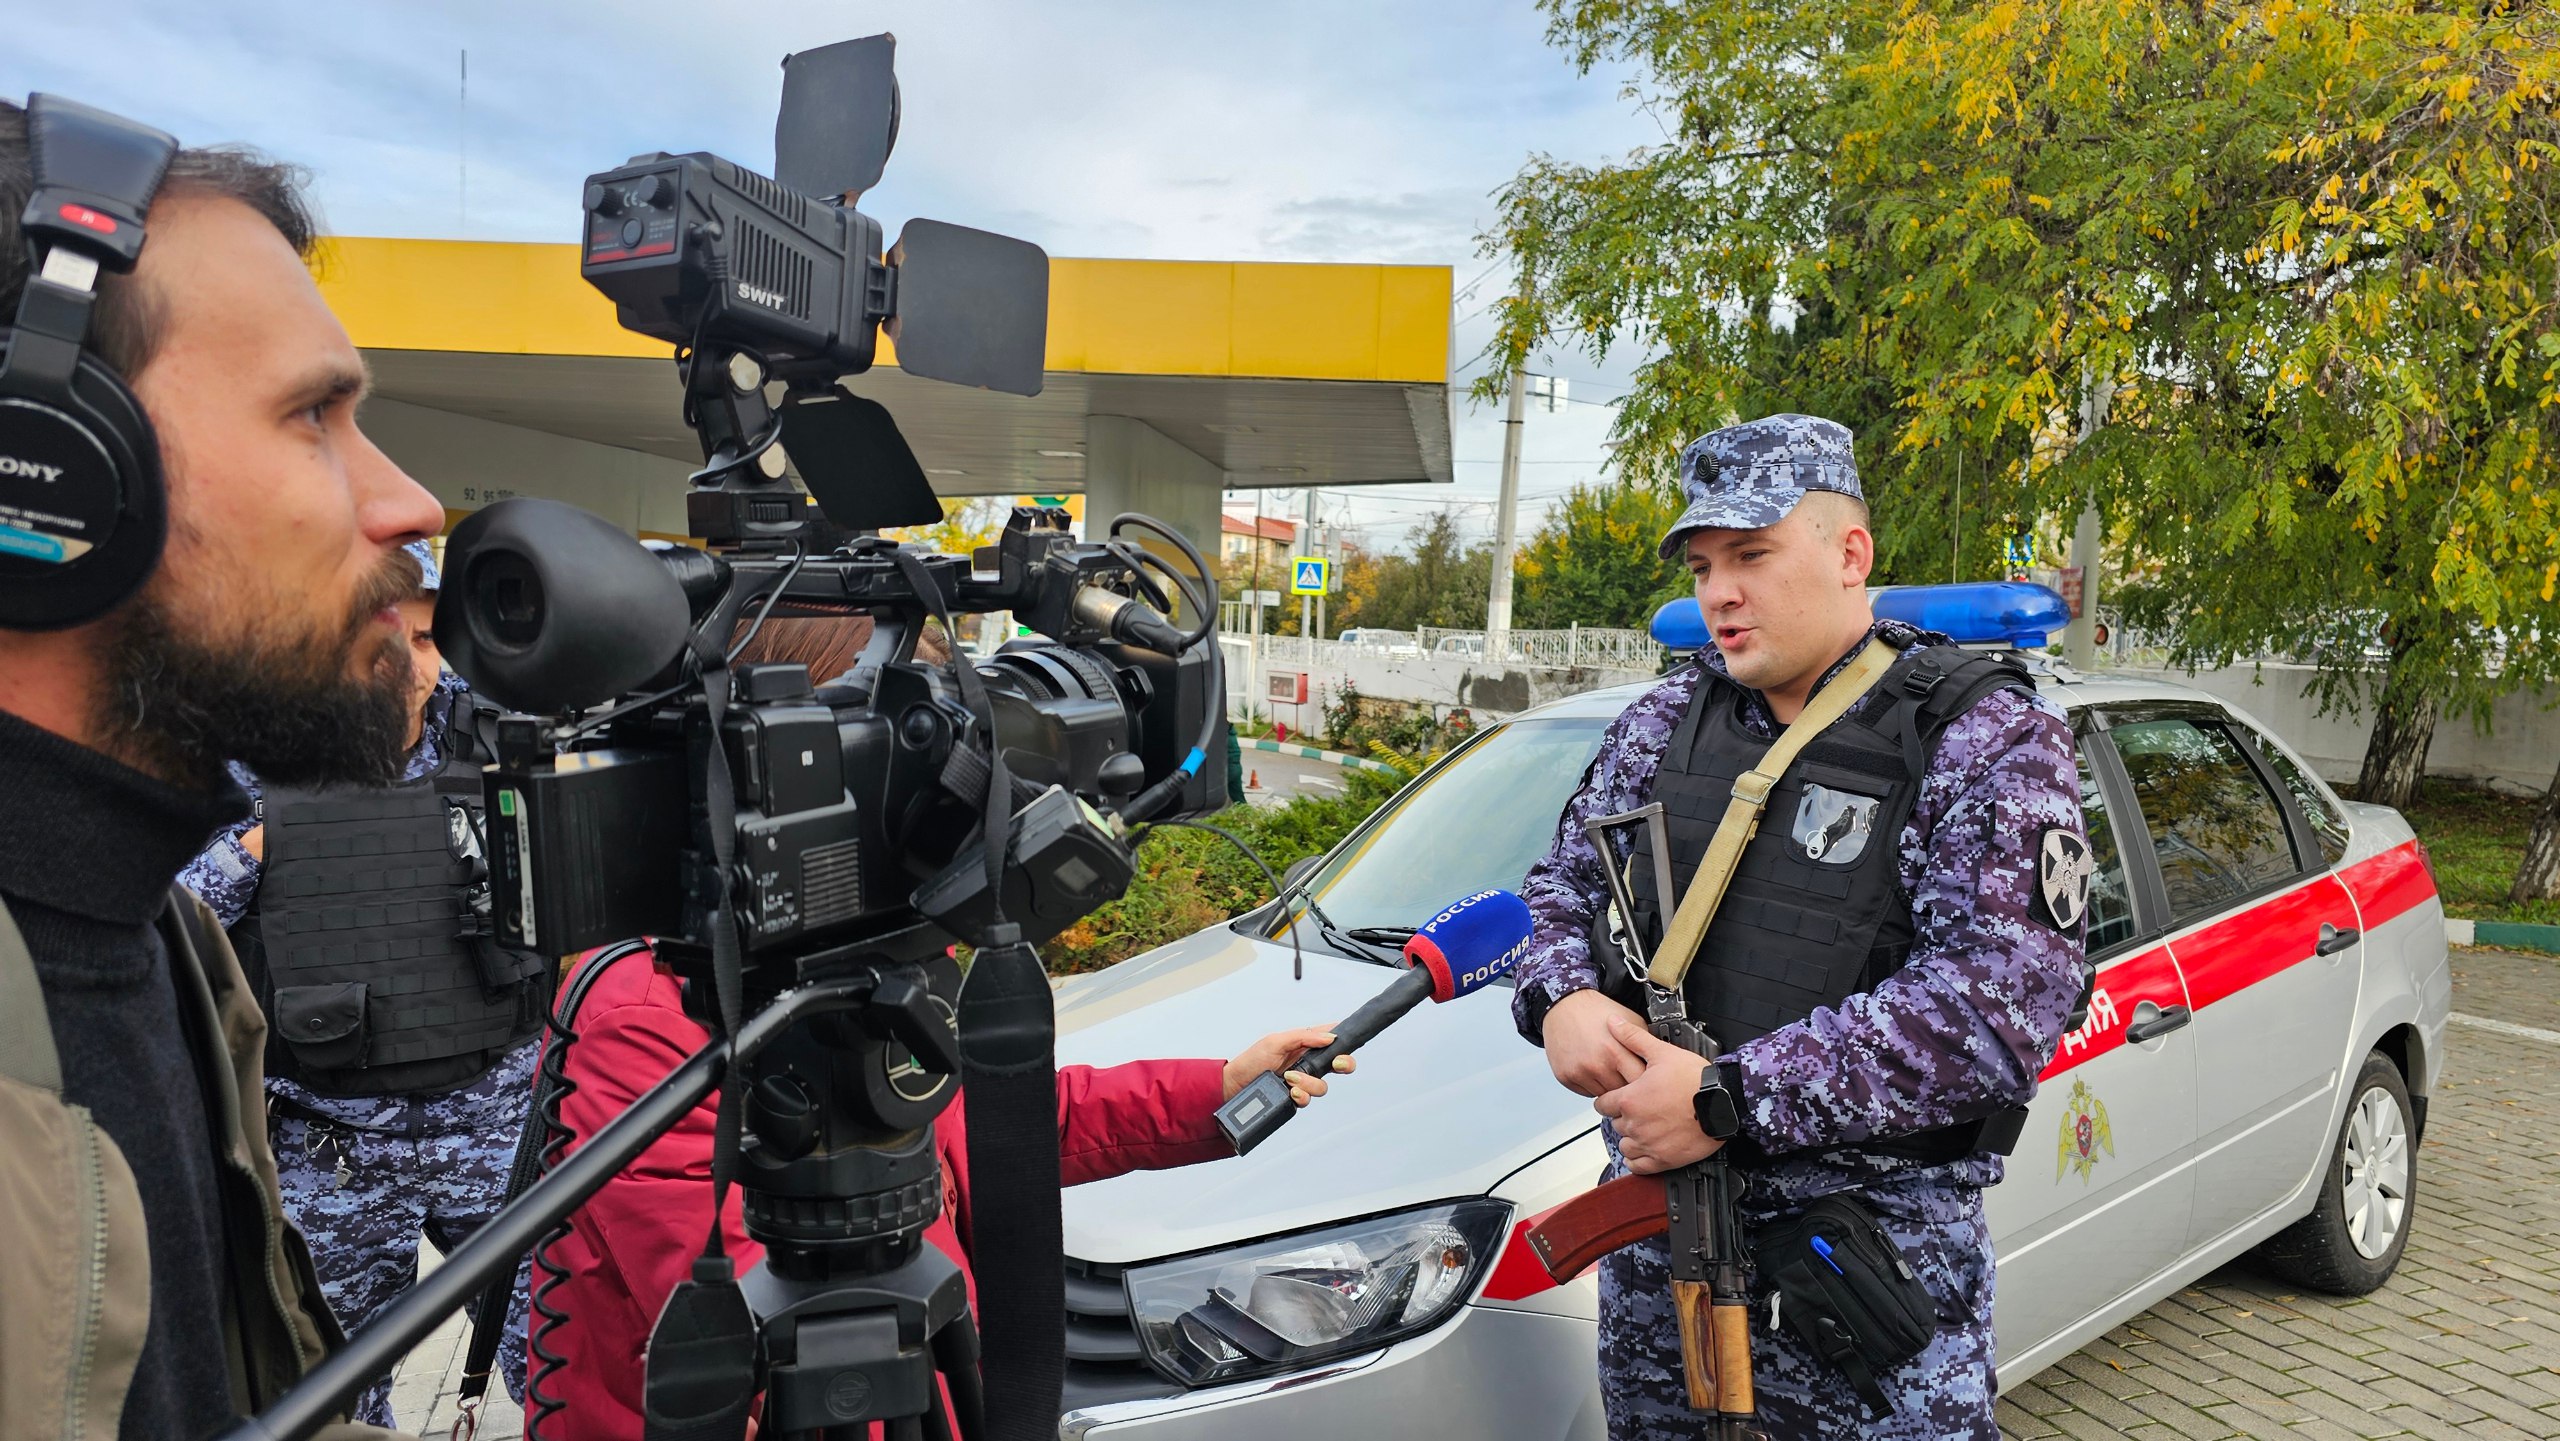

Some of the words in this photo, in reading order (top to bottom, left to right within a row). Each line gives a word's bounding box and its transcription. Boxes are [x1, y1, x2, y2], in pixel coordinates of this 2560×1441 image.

[738, 282, 785, 311] SWIT
[0, 455, 64, 483] ONY
[463, 487, 476, 501] 92
[1424, 889, 1502, 934] РОССИЯ
[1462, 934, 1530, 988] РОССИЯ
[2062, 987, 2120, 1057] ДИЯ
